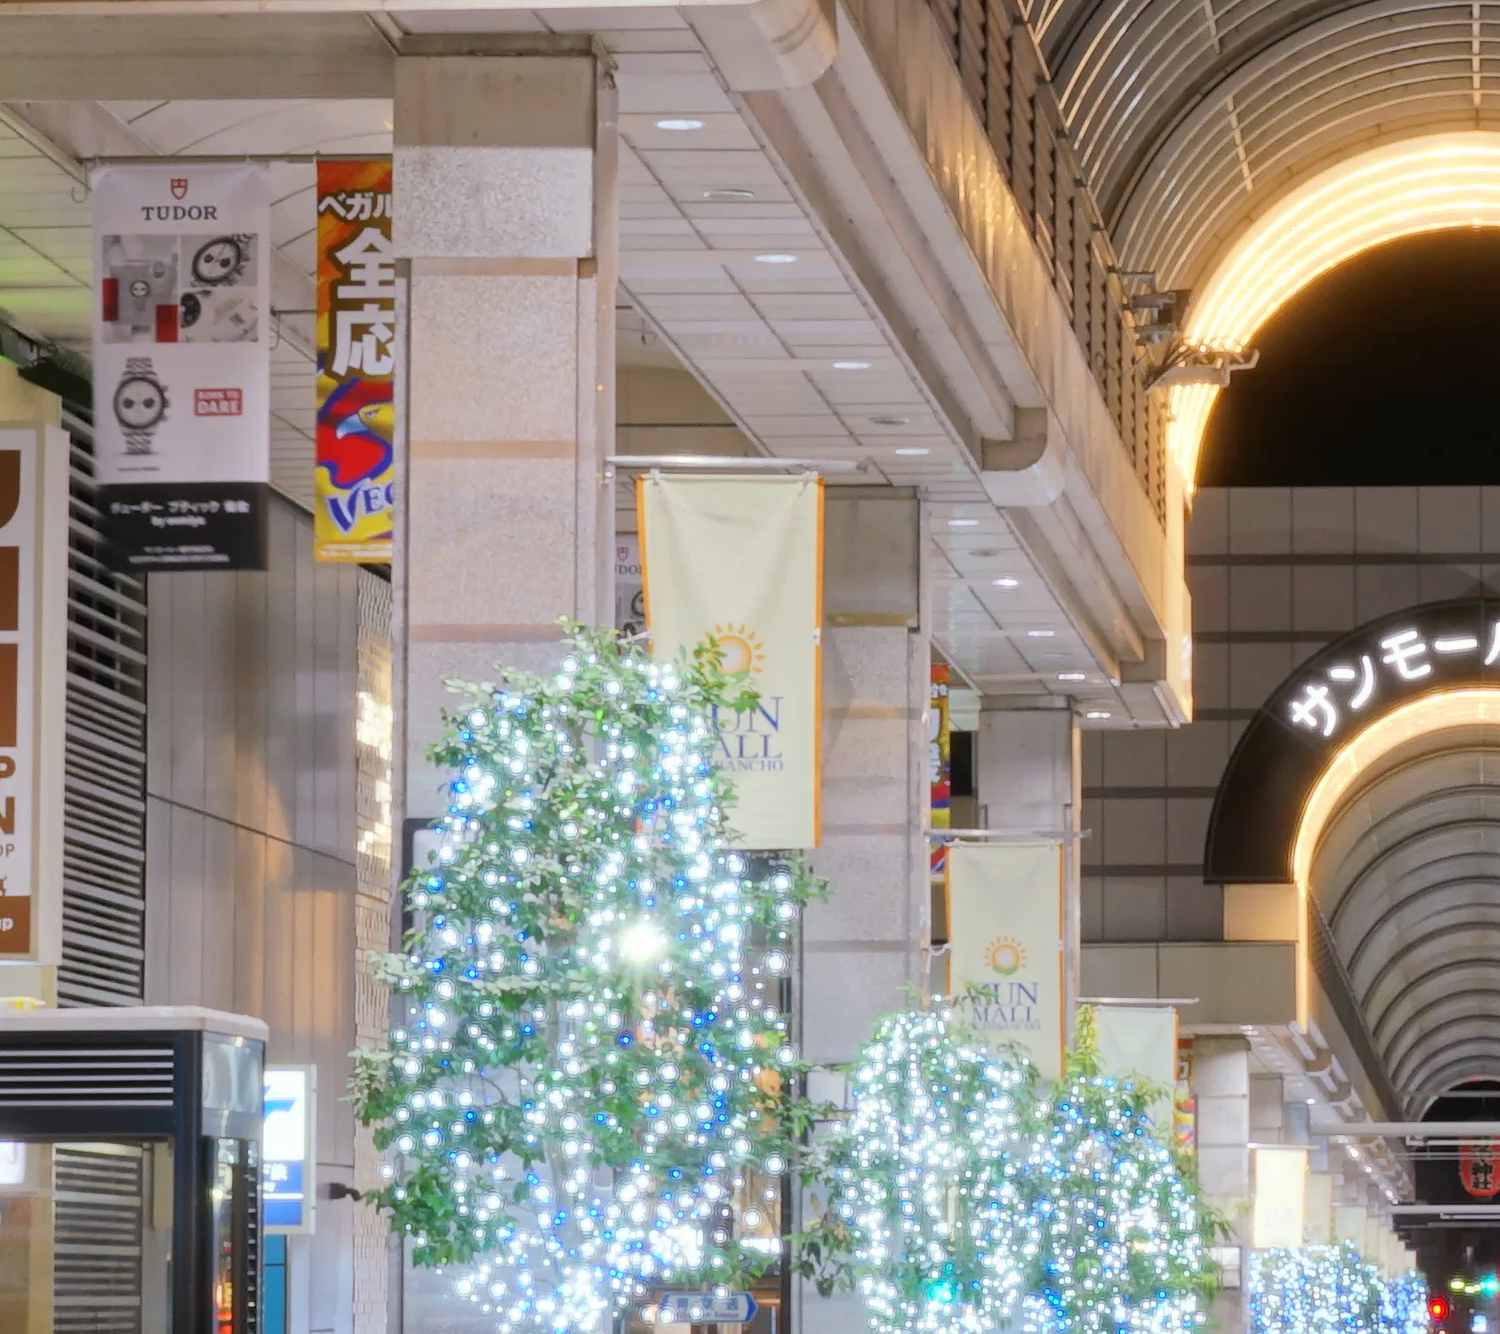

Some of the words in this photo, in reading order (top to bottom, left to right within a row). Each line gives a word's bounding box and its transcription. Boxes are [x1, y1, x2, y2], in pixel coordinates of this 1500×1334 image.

[141, 205, 218, 221] TUDOR
[711, 697, 784, 733] UN
[715, 734, 783, 759] ALL
